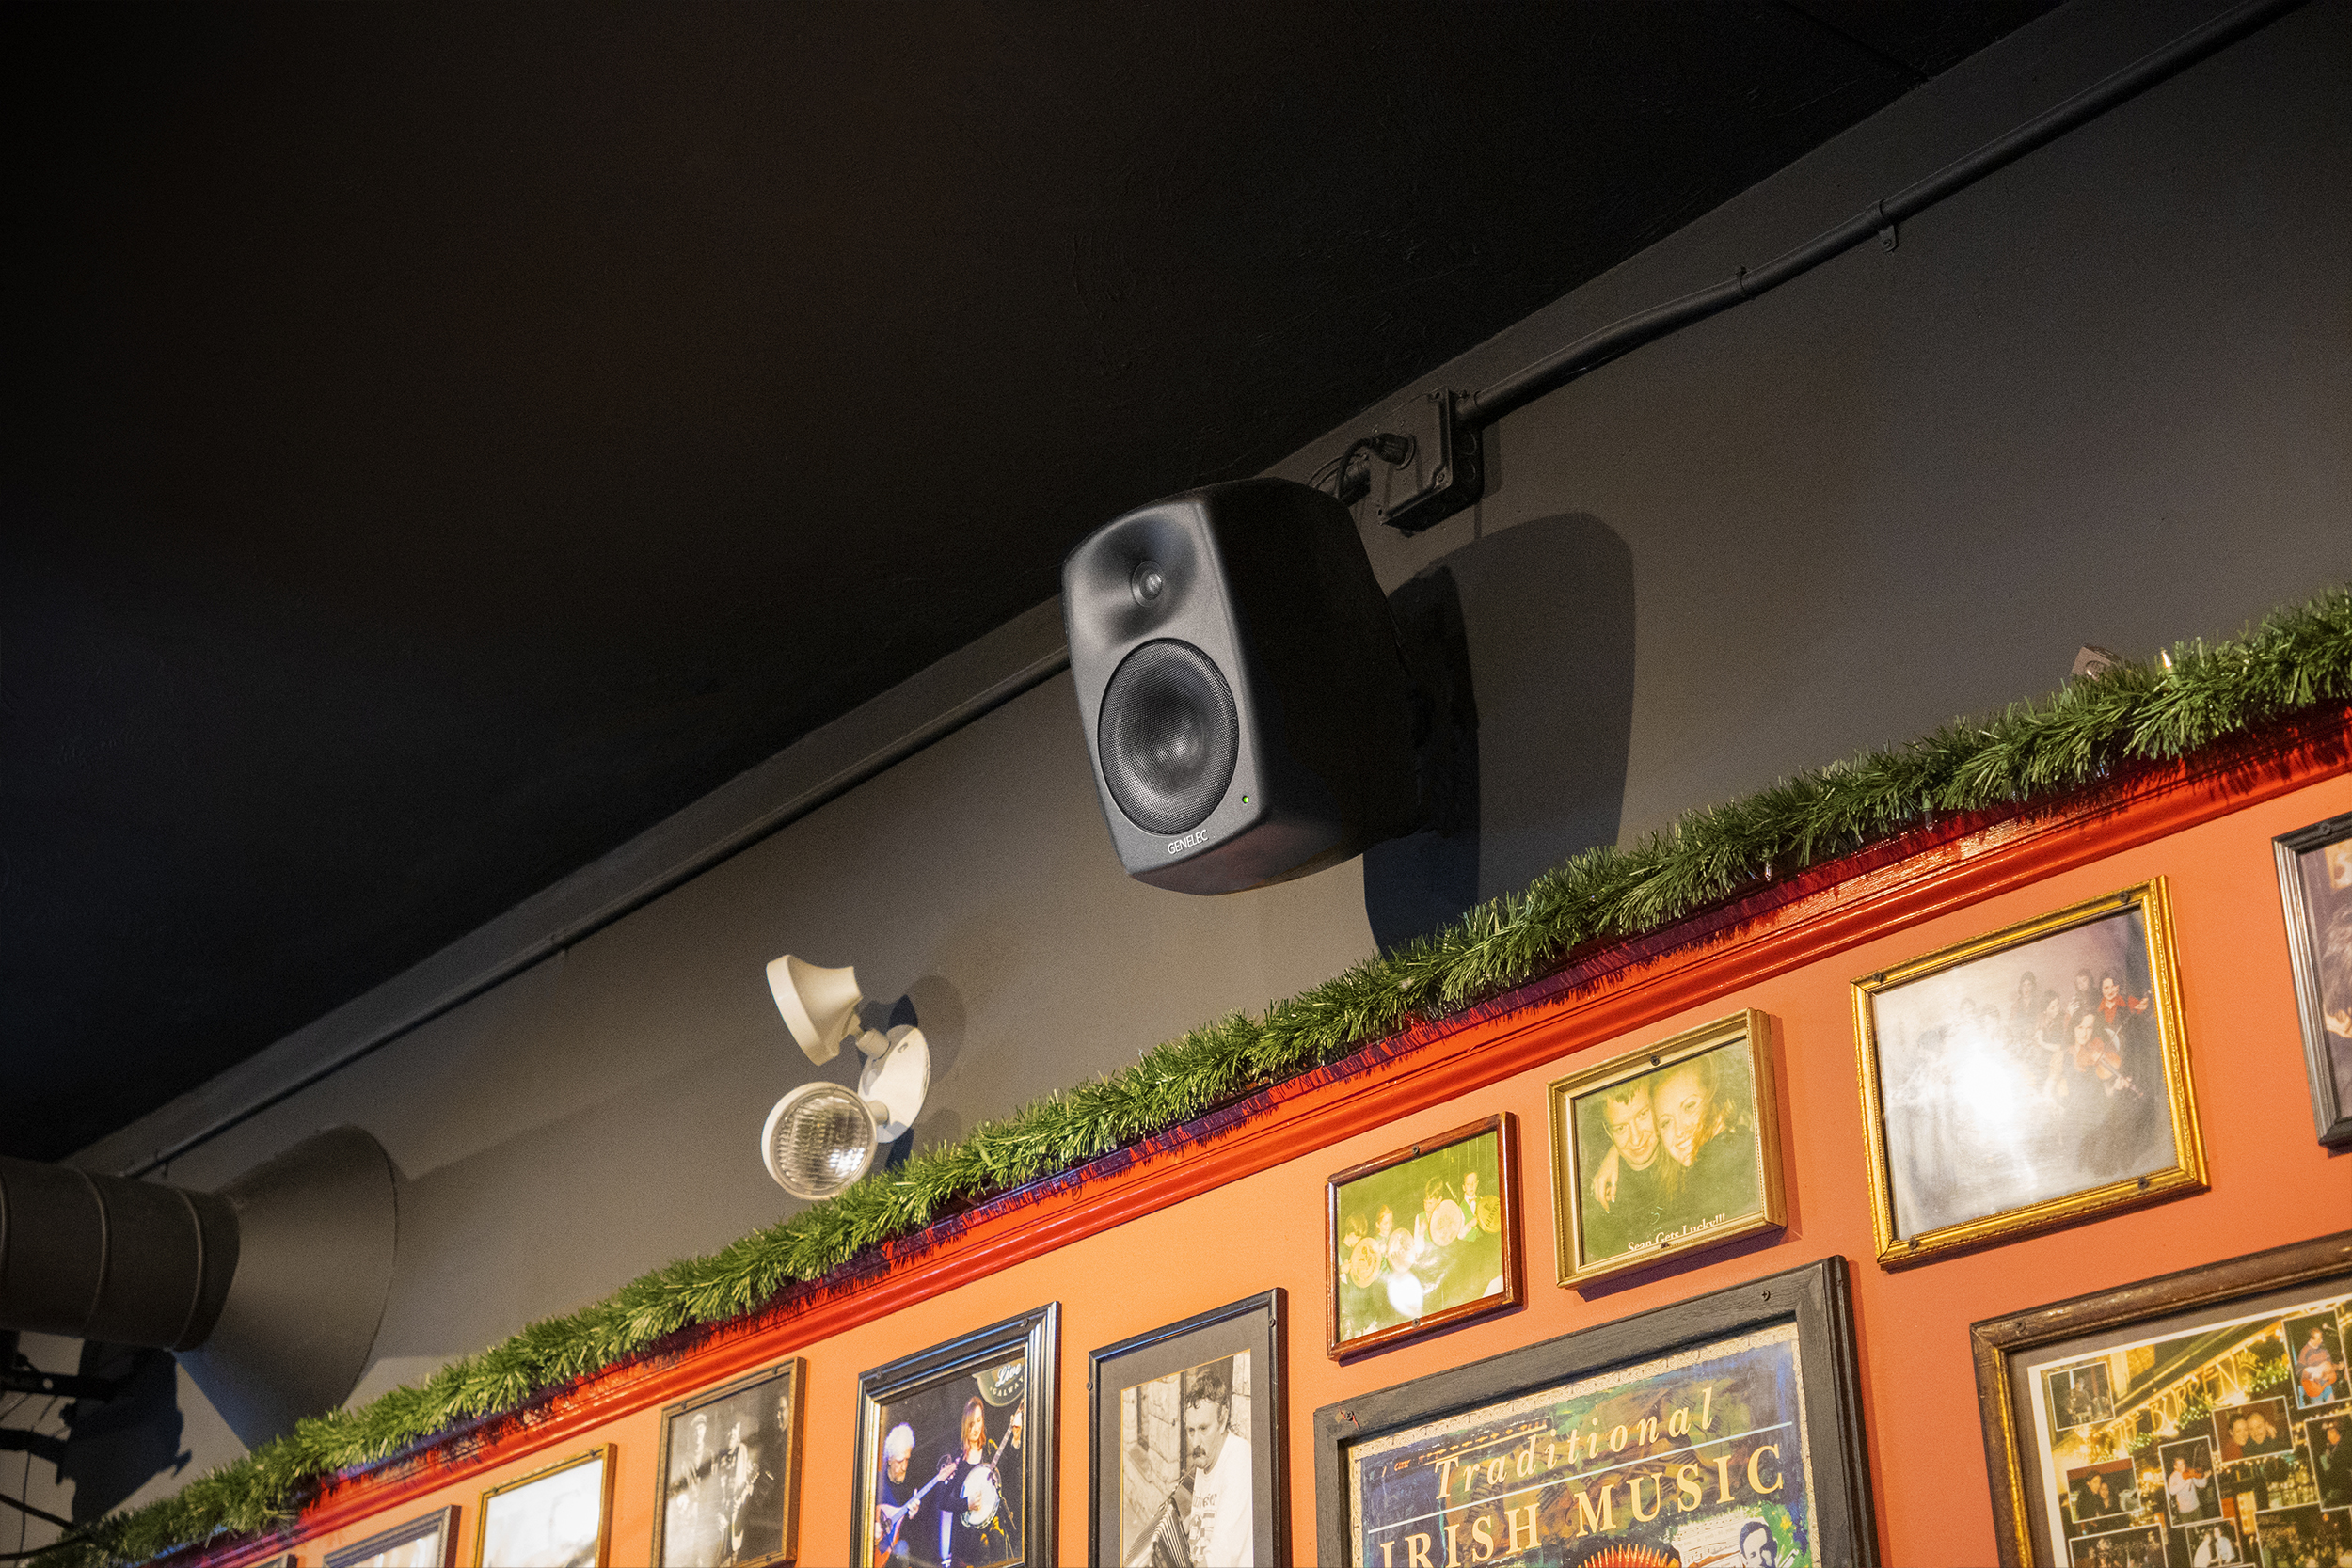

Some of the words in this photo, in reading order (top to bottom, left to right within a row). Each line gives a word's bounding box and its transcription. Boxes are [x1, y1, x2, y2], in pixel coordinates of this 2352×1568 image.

[1168, 829, 1209, 855] GENELEC
[1628, 1241, 1652, 1252] Sean
[1655, 1231, 1679, 1243] Gets
[995, 1363, 1022, 1387] Live
[2149, 1354, 2241, 1432] BURREN
[1435, 1386, 1713, 1500] Traditional
[1379, 1502, 1542, 1568] IRISH
[1573, 1444, 1785, 1538] MUSIC
